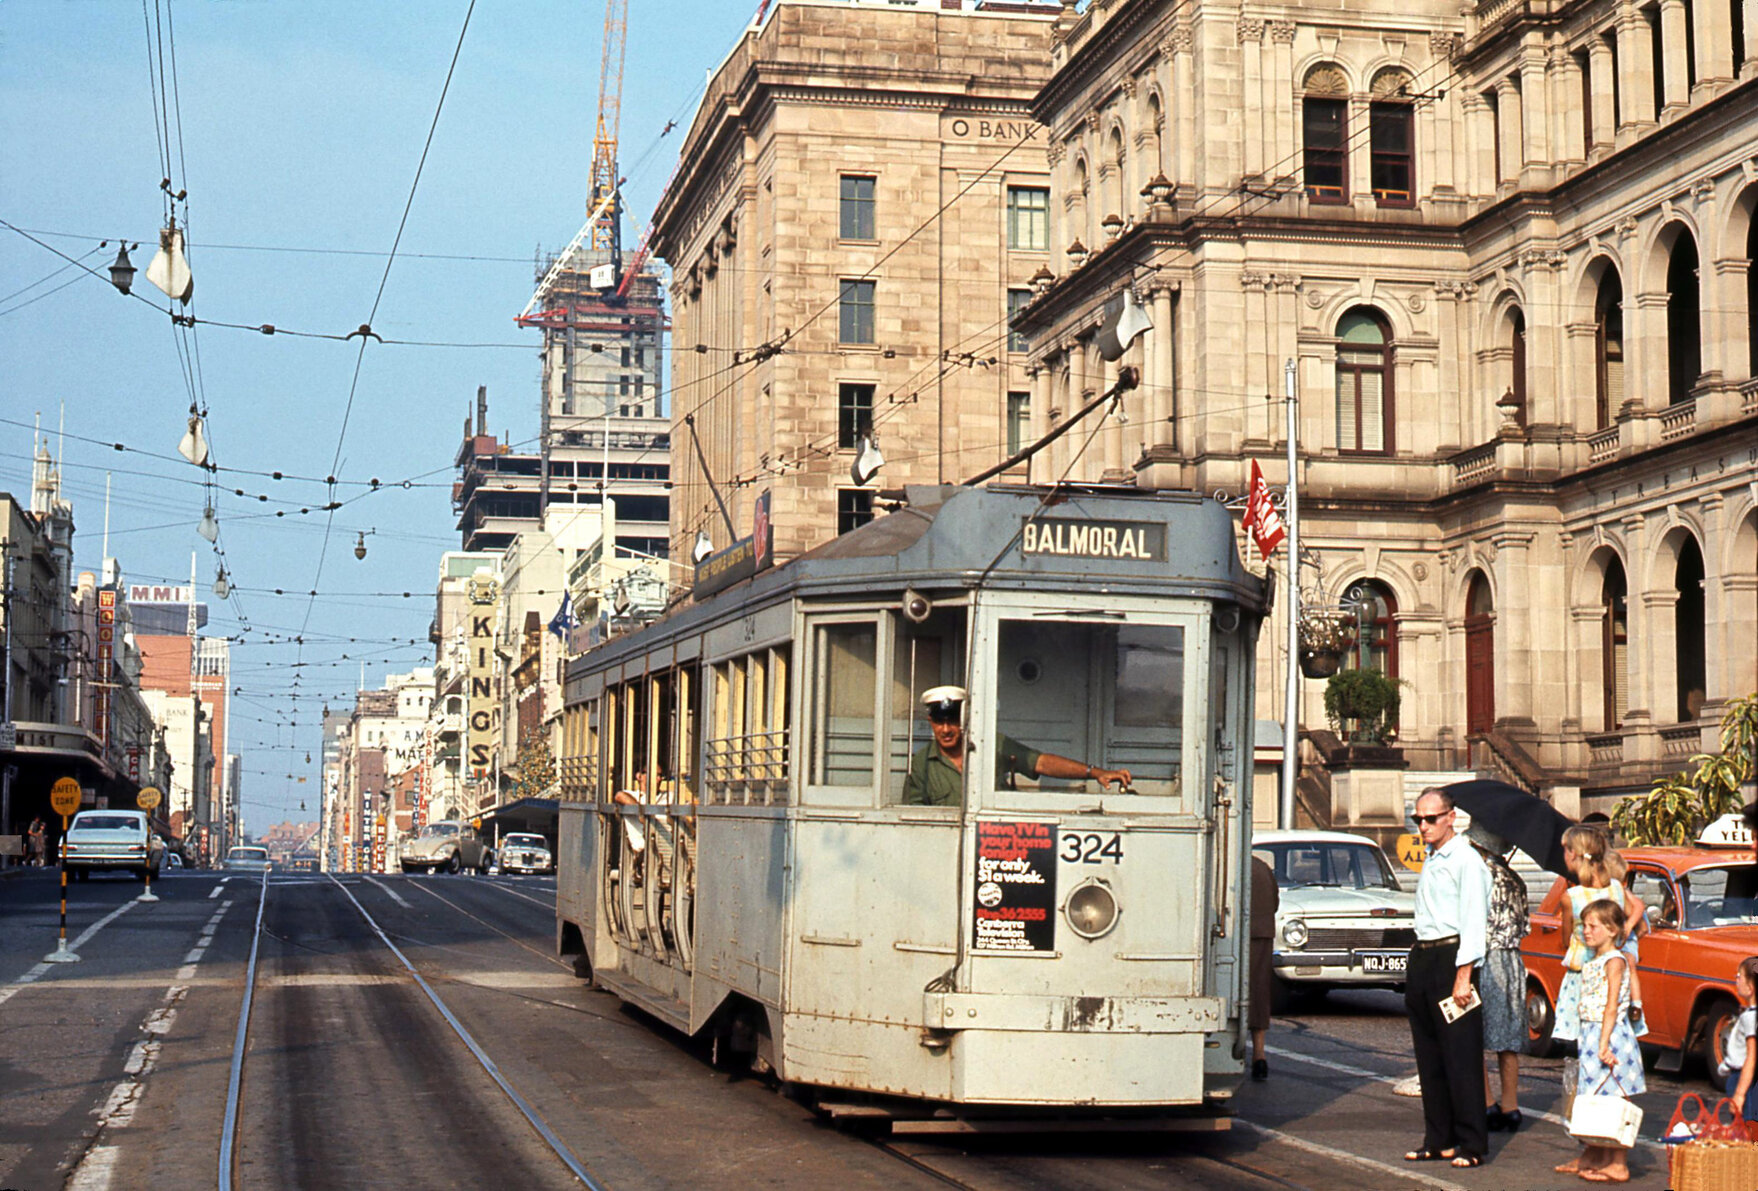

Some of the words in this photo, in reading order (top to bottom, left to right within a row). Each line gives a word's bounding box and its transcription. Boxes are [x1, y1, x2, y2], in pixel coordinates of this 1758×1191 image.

[979, 120, 1037, 140] BANK
[1023, 523, 1152, 558] BALMORAL
[132, 586, 180, 601] MMI
[471, 616, 493, 766] KINGS
[51, 784, 78, 793] SAFETY
[363, 793, 371, 841] WINTER
[979, 823, 1015, 835] Have
[1016, 824, 1035, 837] TV
[1036, 824, 1049, 837] in
[980, 837, 1012, 850] your
[1012, 836, 1052, 848] home
[1060, 832, 1124, 865] 324
[979, 848, 1029, 861] tonight
[979, 856, 1000, 870] for
[1000, 857, 1030, 874] only
[993, 872, 1003, 882] a
[1000, 907, 1016, 920] 36
[976, 917, 1025, 929] Canberra
[976, 928, 1025, 938] Television
